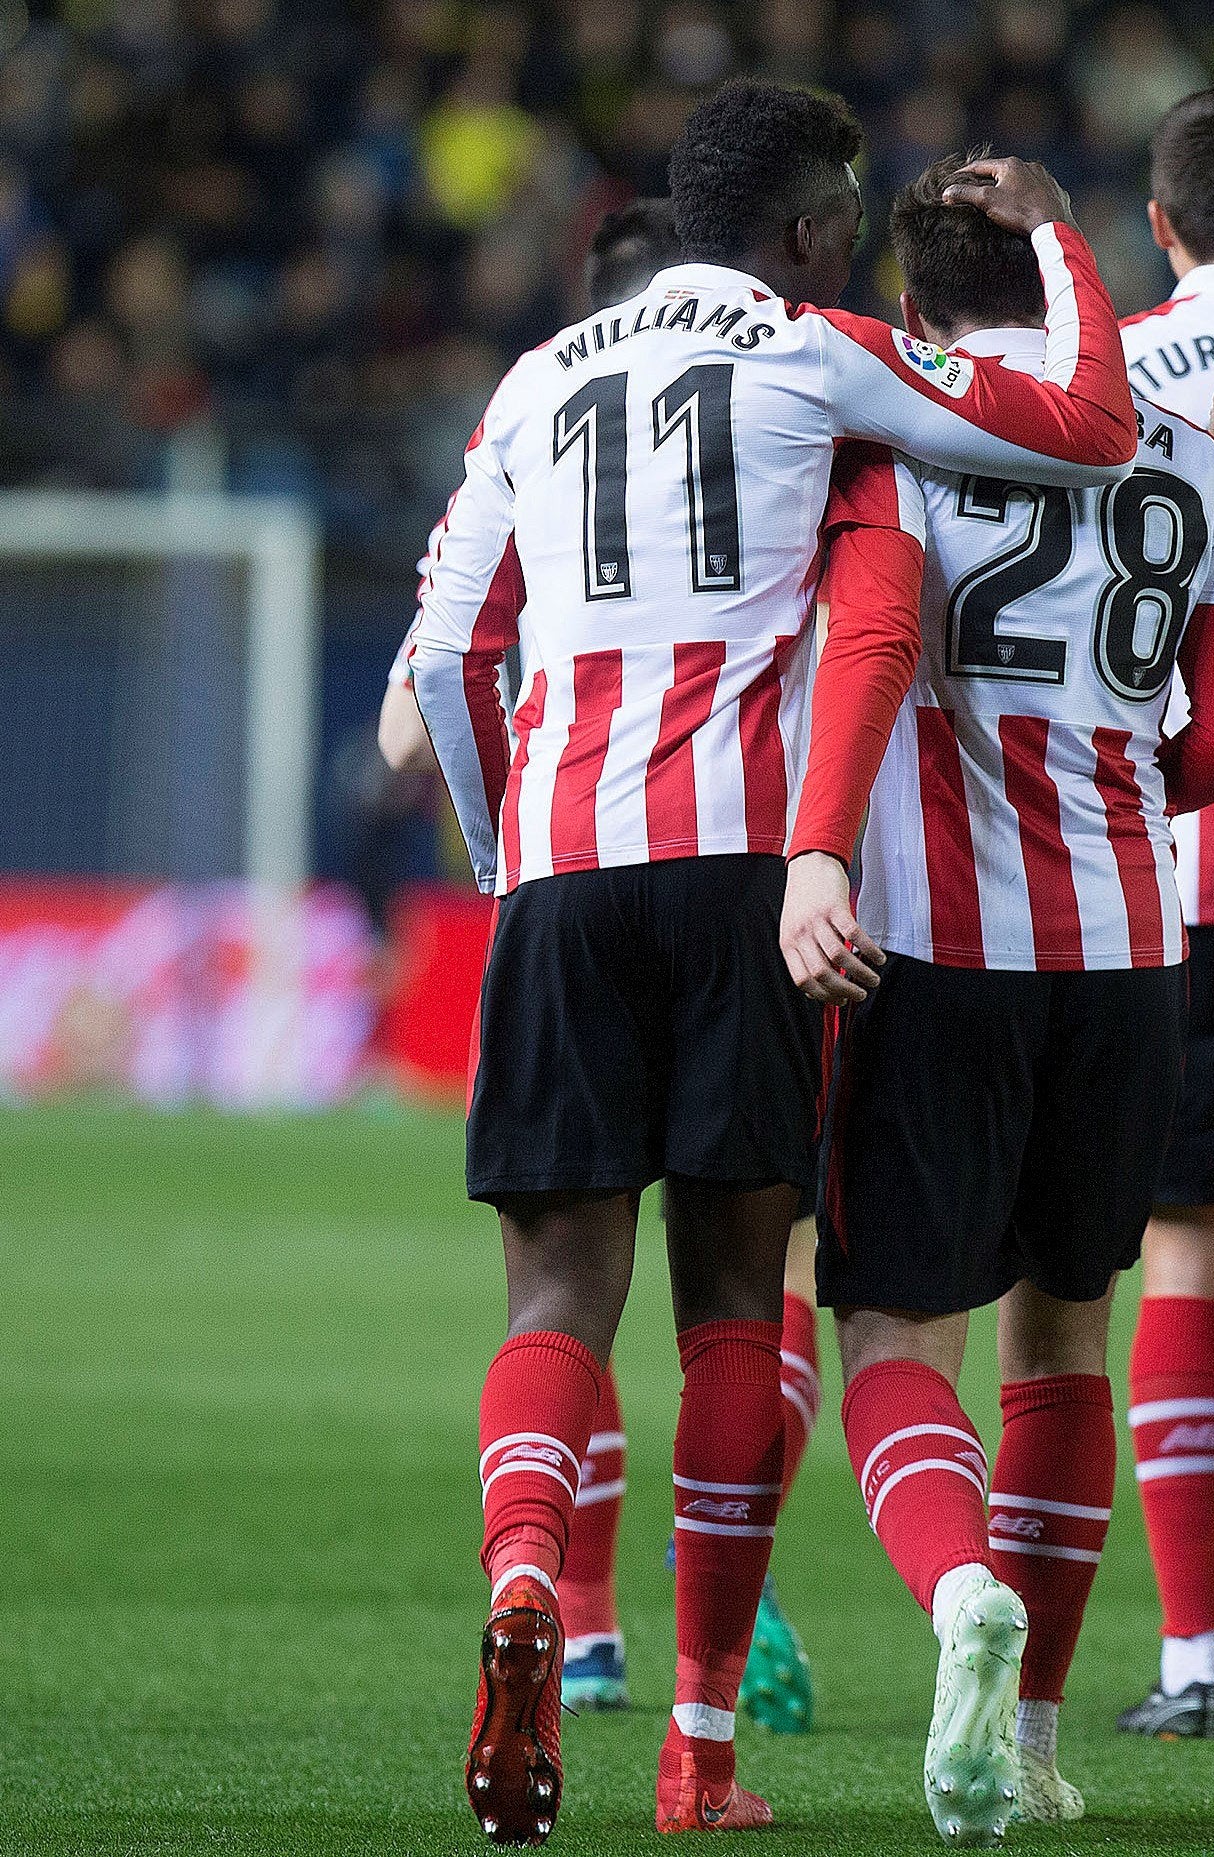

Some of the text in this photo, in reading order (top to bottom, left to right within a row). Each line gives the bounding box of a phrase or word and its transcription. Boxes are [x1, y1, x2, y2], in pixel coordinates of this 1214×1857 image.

[554, 297, 777, 372] WILLIAMS
[552, 362, 741, 603] 11
[944, 466, 1208, 702] 28
